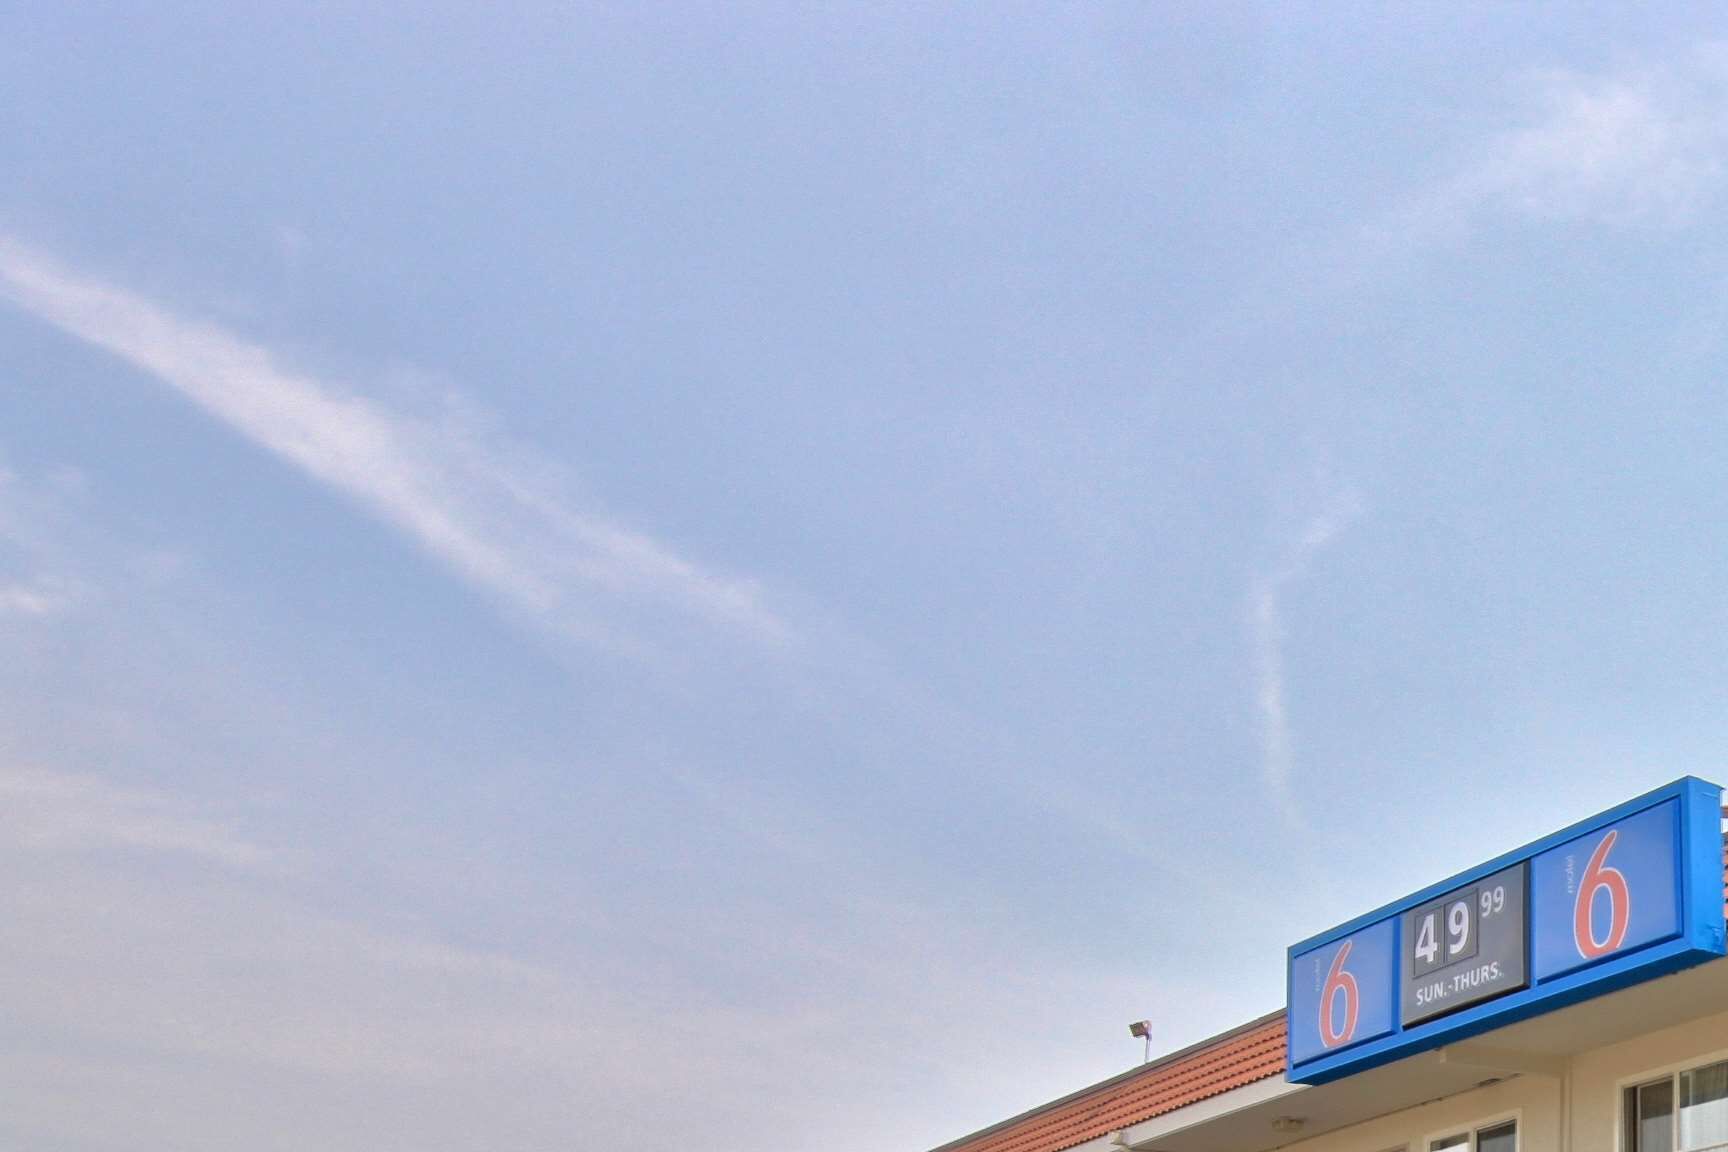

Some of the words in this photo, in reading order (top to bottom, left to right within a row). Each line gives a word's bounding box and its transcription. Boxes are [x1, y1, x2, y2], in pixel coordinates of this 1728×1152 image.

[1415, 901, 1469, 962] 49
[1481, 885, 1505, 917] 99
[1573, 829, 1630, 960] 6
[1318, 939, 1359, 1048] 6
